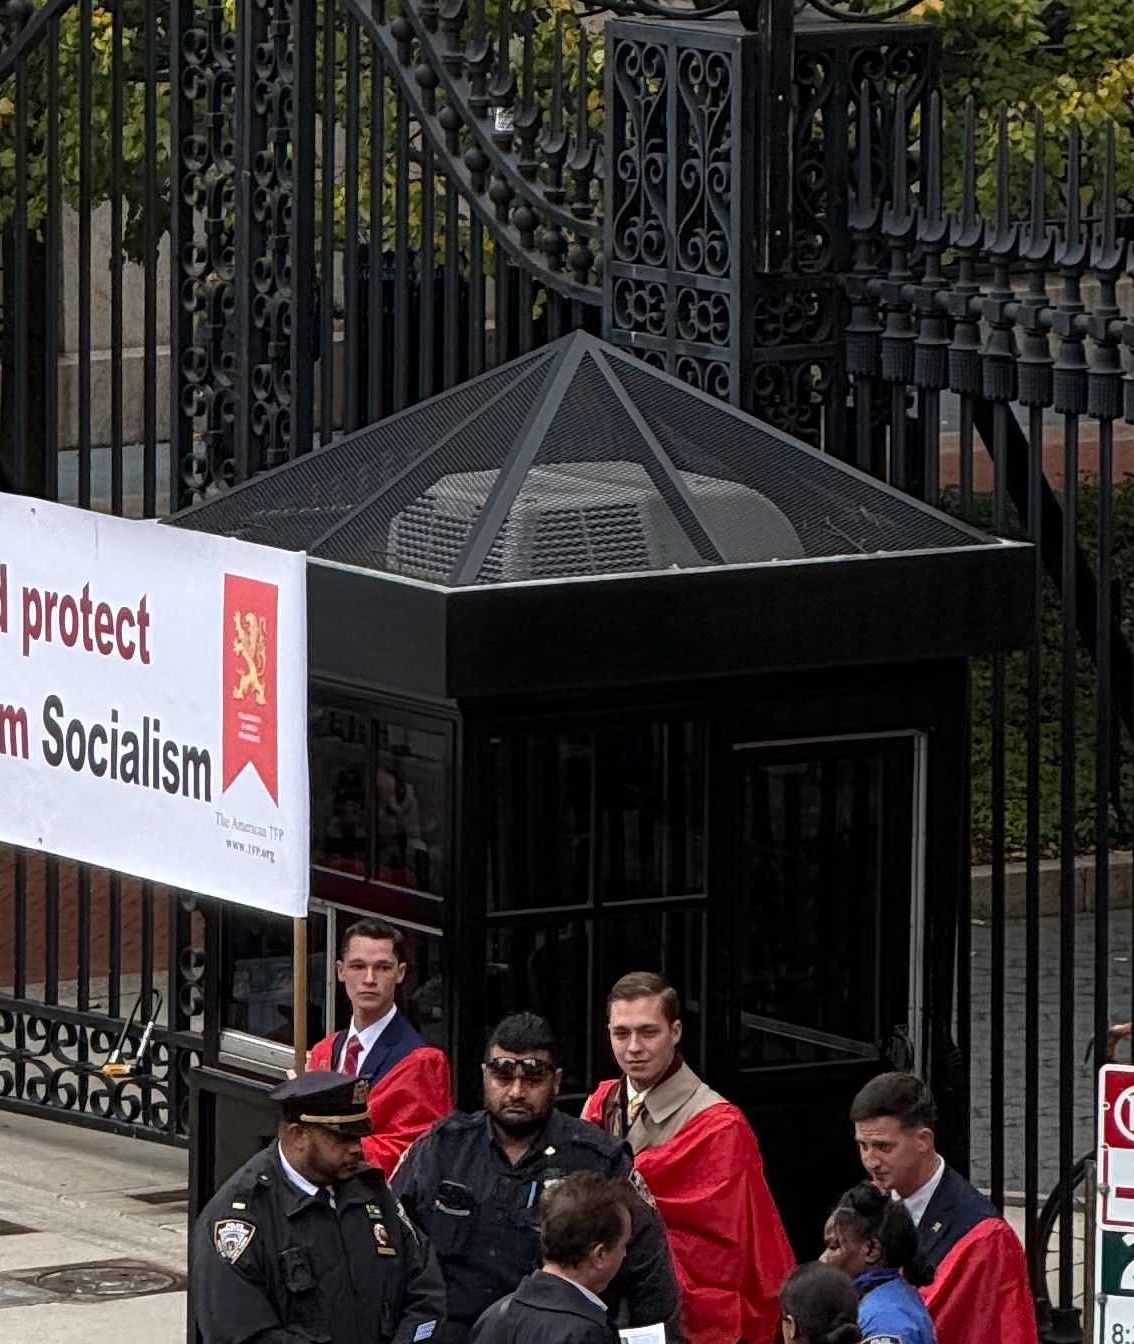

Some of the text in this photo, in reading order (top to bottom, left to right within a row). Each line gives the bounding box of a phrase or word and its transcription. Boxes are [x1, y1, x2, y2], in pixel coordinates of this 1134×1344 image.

[22, 581, 151, 664] protect
[41, 694, 212, 802] Socialism
[215, 811, 230, 828] The
